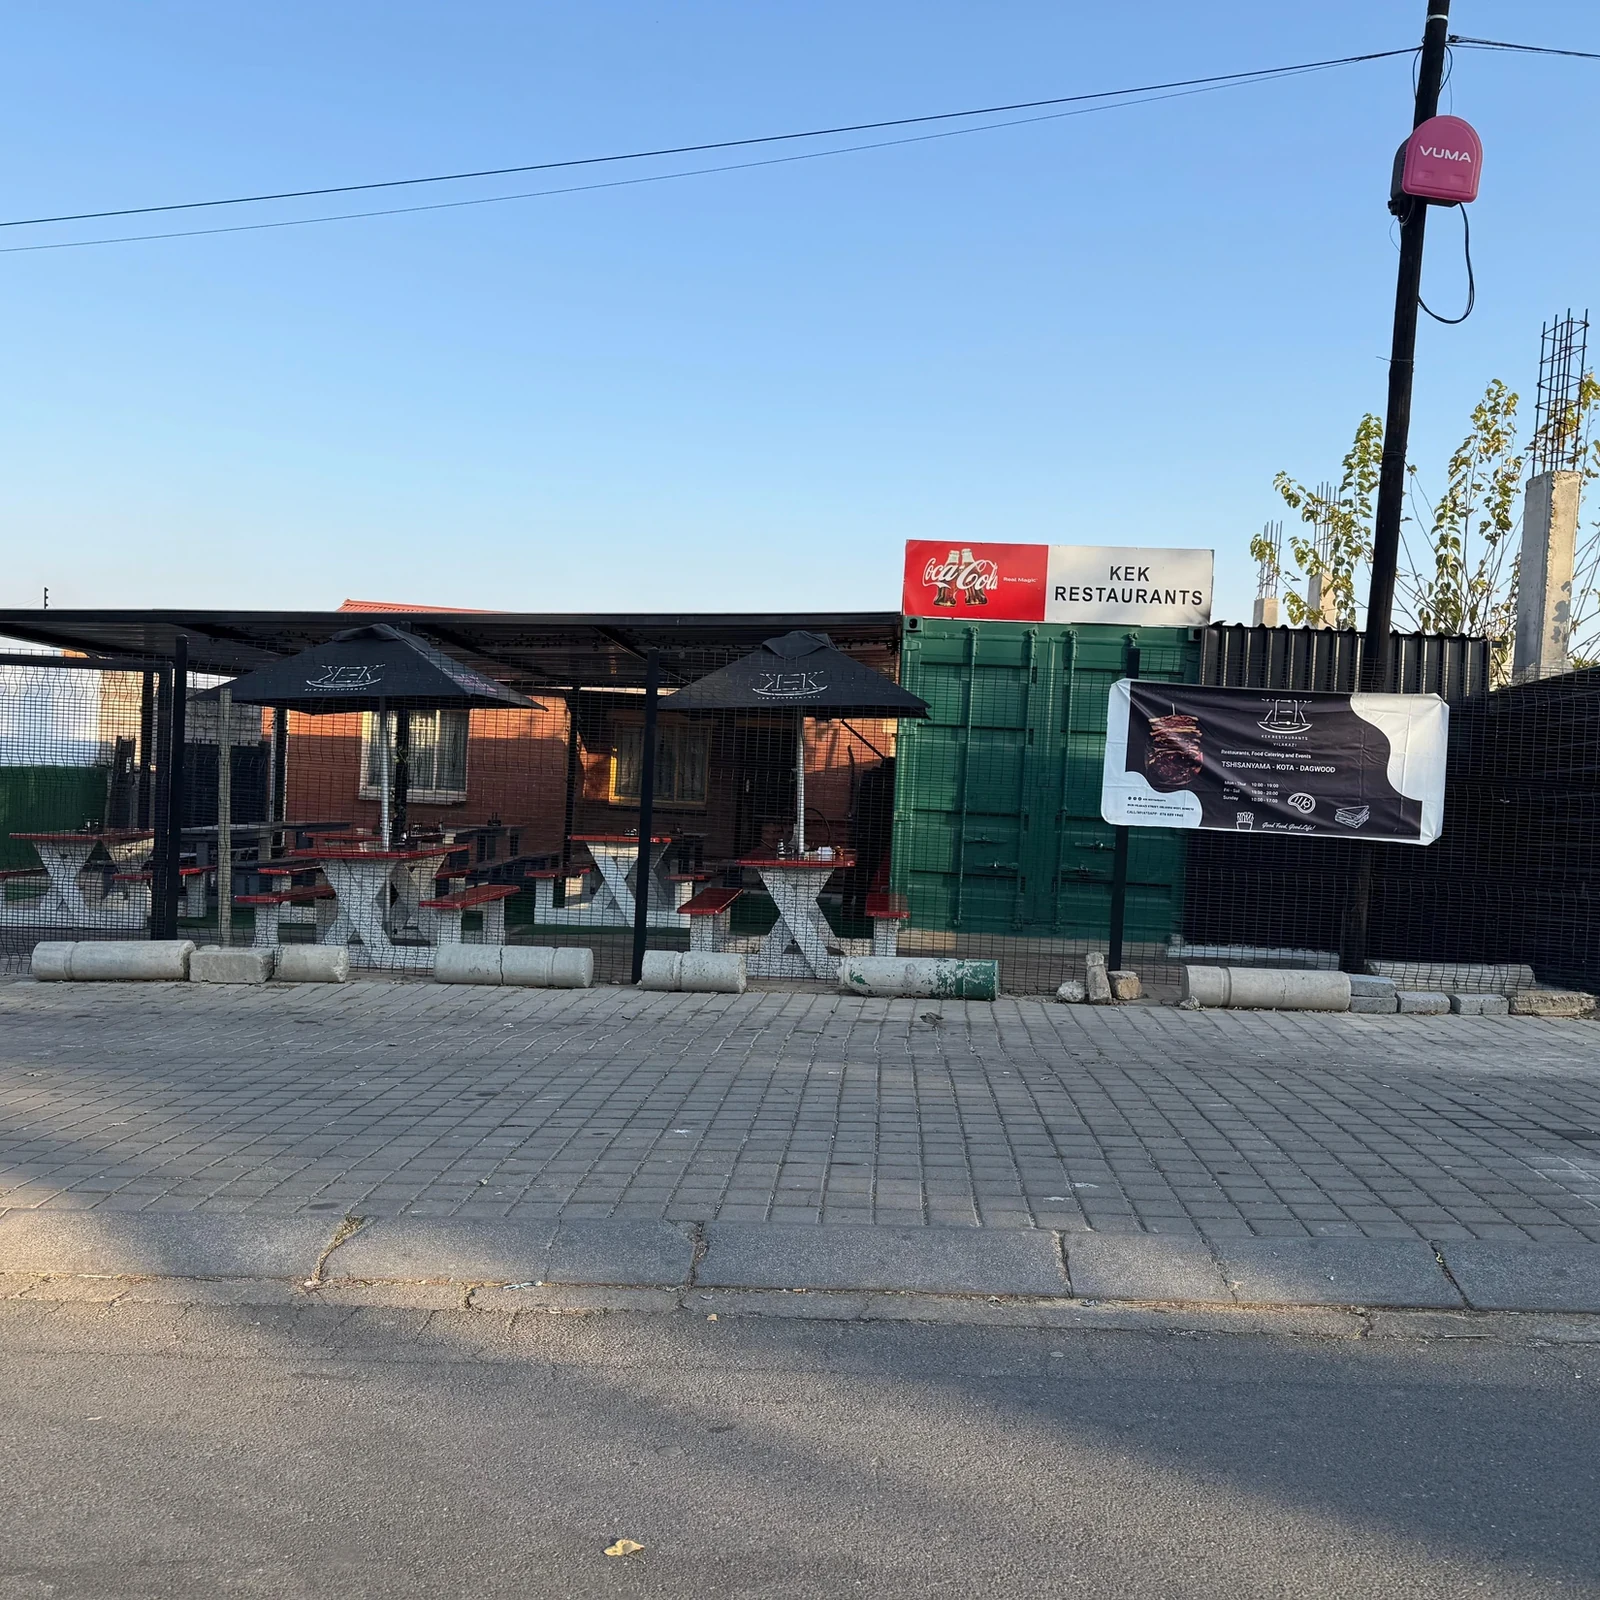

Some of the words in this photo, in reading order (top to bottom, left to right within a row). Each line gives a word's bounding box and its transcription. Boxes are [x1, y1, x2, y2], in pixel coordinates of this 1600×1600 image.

[1420, 145, 1472, 163] VUMA
[922, 558, 998, 590] Coca-Cola
[1109, 565, 1150, 582] KEK
[1054, 586, 1202, 605] RESTAURANTS
[1221, 761, 1271, 770] TSHISANYAMA
[1299, 765, 1336, 773] DAGWOOD
[1261, 821, 1276, 829] Good
[1288, 823, 1302, 831] Good
